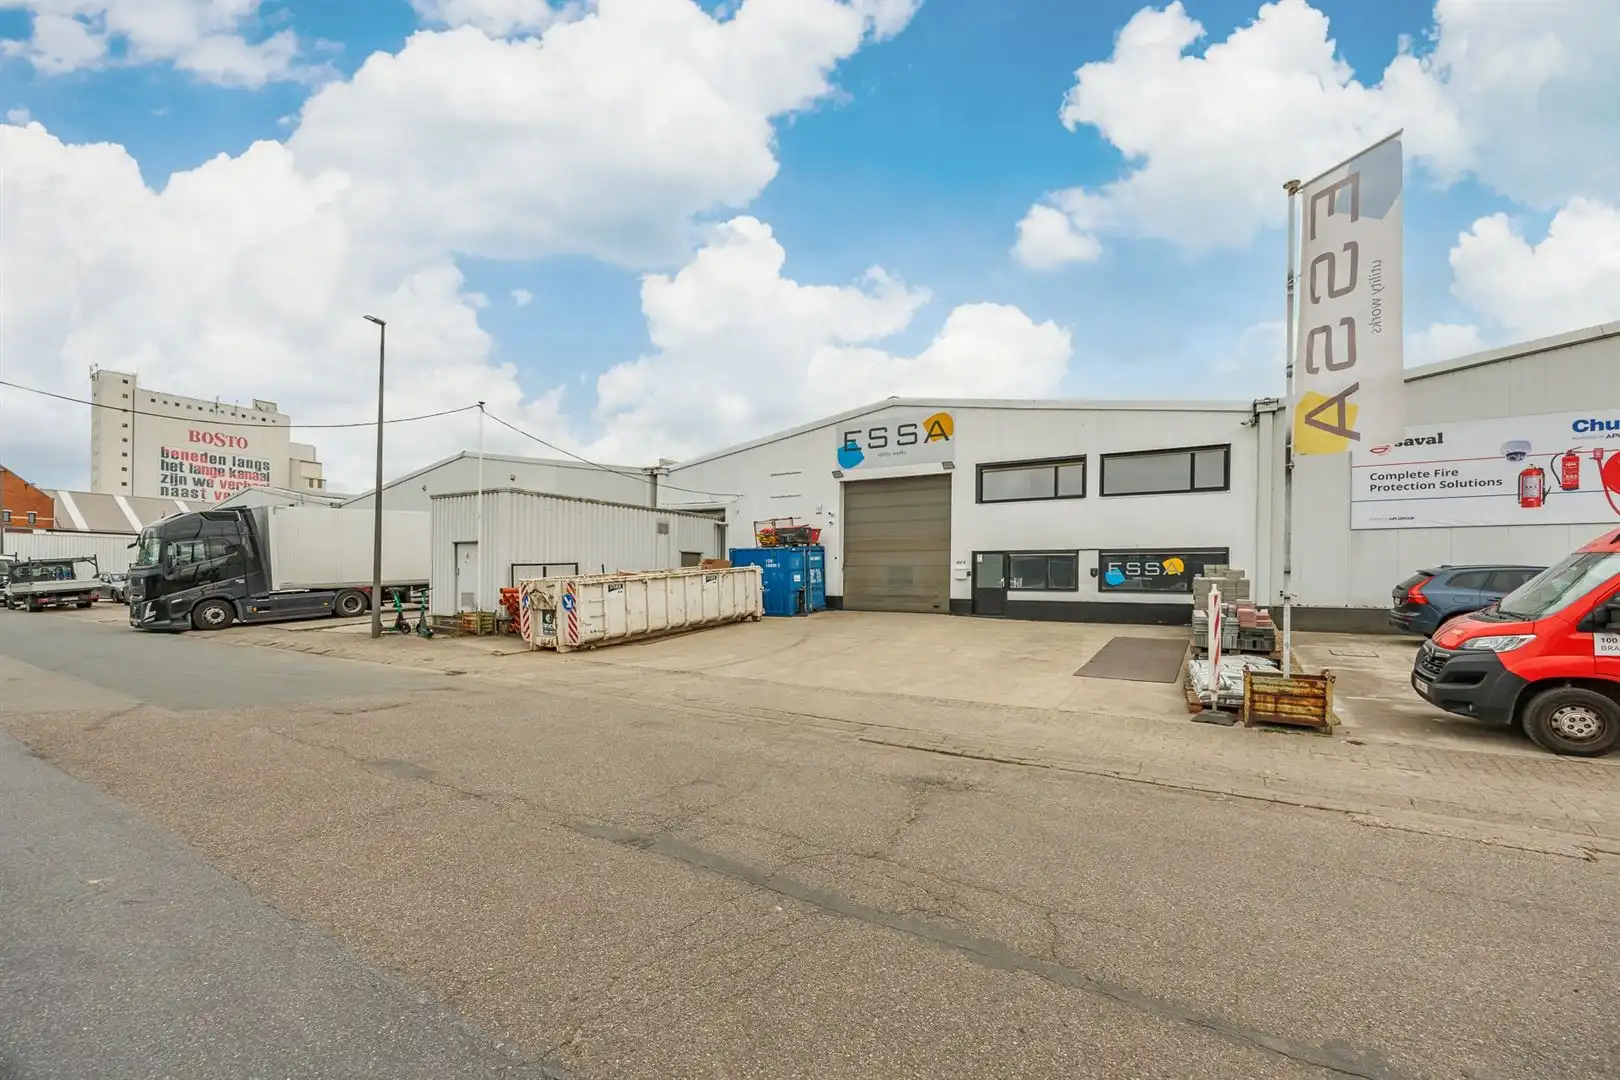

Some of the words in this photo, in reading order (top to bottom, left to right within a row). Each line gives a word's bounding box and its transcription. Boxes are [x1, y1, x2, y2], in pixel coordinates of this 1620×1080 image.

[188, 429, 249, 450] BOSTO
[844, 420, 950, 452] ESSA
[160, 446, 226, 465] beneden
[232, 455, 270, 472] langs
[160, 459, 184, 472] het
[189, 463, 225, 478] lange
[228, 467, 270, 482] kanaal
[1369, 470, 1430, 482] Complete
[1434, 468, 1459, 477] Fire
[160, 473, 187, 486] zijn
[192, 476, 214, 488] we
[1369, 481, 1436, 492] Protection
[1439, 478, 1503, 489] Solutions
[160, 486, 206, 500] naast
[1107, 561, 1181, 576] ESSA
